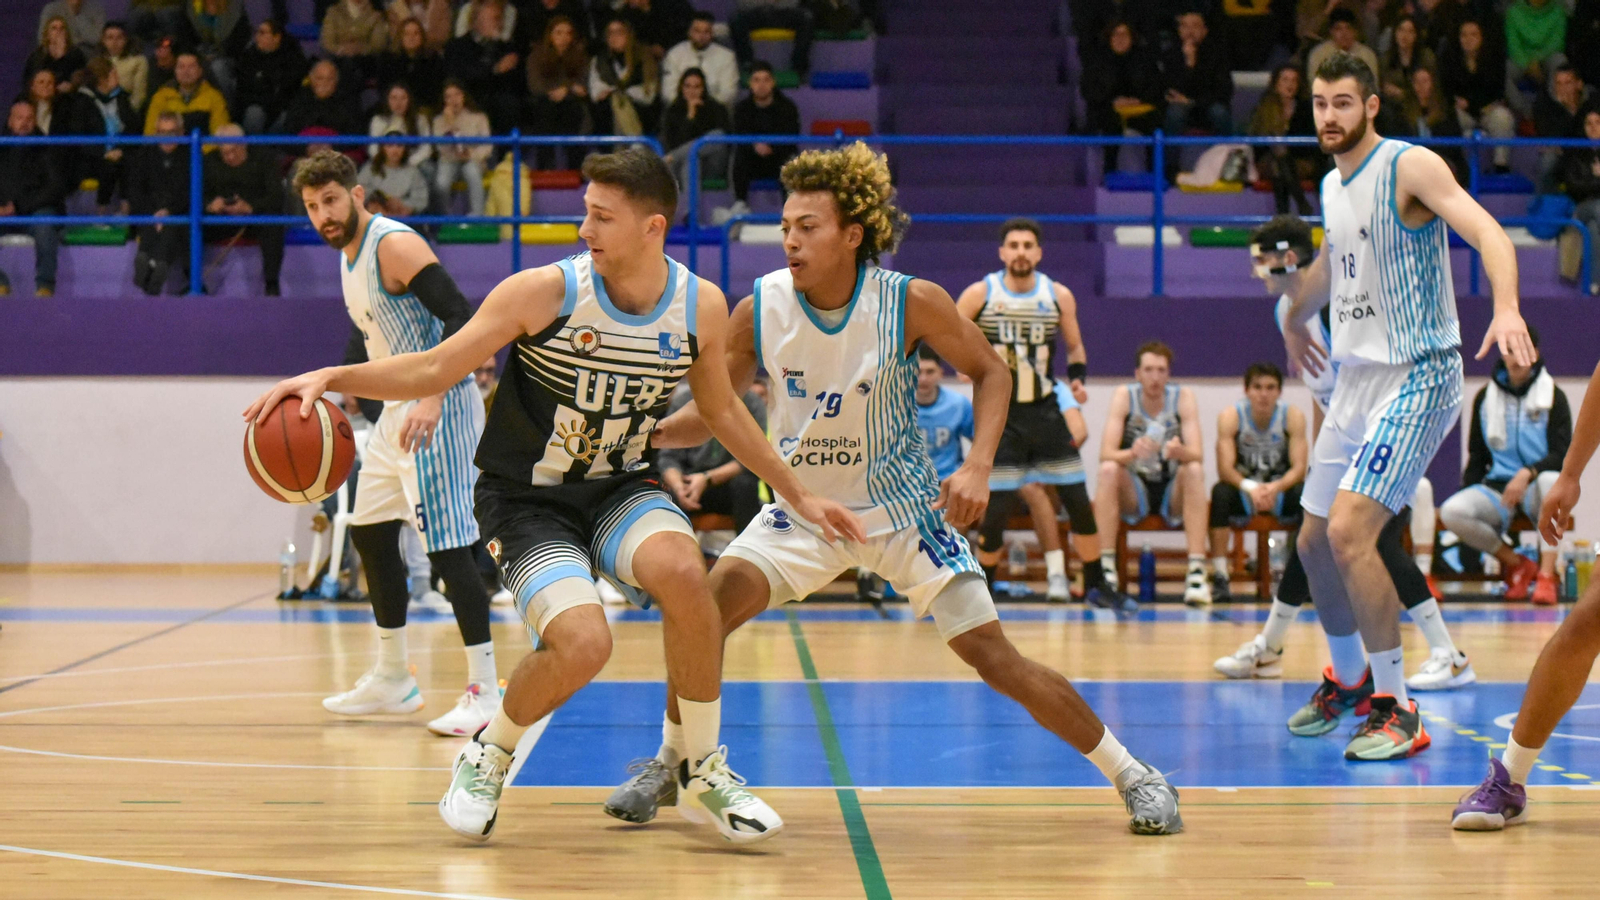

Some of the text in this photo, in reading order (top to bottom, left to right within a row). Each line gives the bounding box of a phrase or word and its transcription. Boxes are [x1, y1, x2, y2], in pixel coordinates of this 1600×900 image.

[1341, 252, 1356, 280] 18
[1000, 321, 1045, 344] ULB
[575, 367, 665, 415] ULB
[811, 391, 843, 420] 19
[801, 436, 861, 450] Hospital
[1354, 440, 1393, 475] 18
[791, 451, 862, 467] OCHOA
[415, 502, 428, 532] 5
[918, 529, 961, 569] 19
